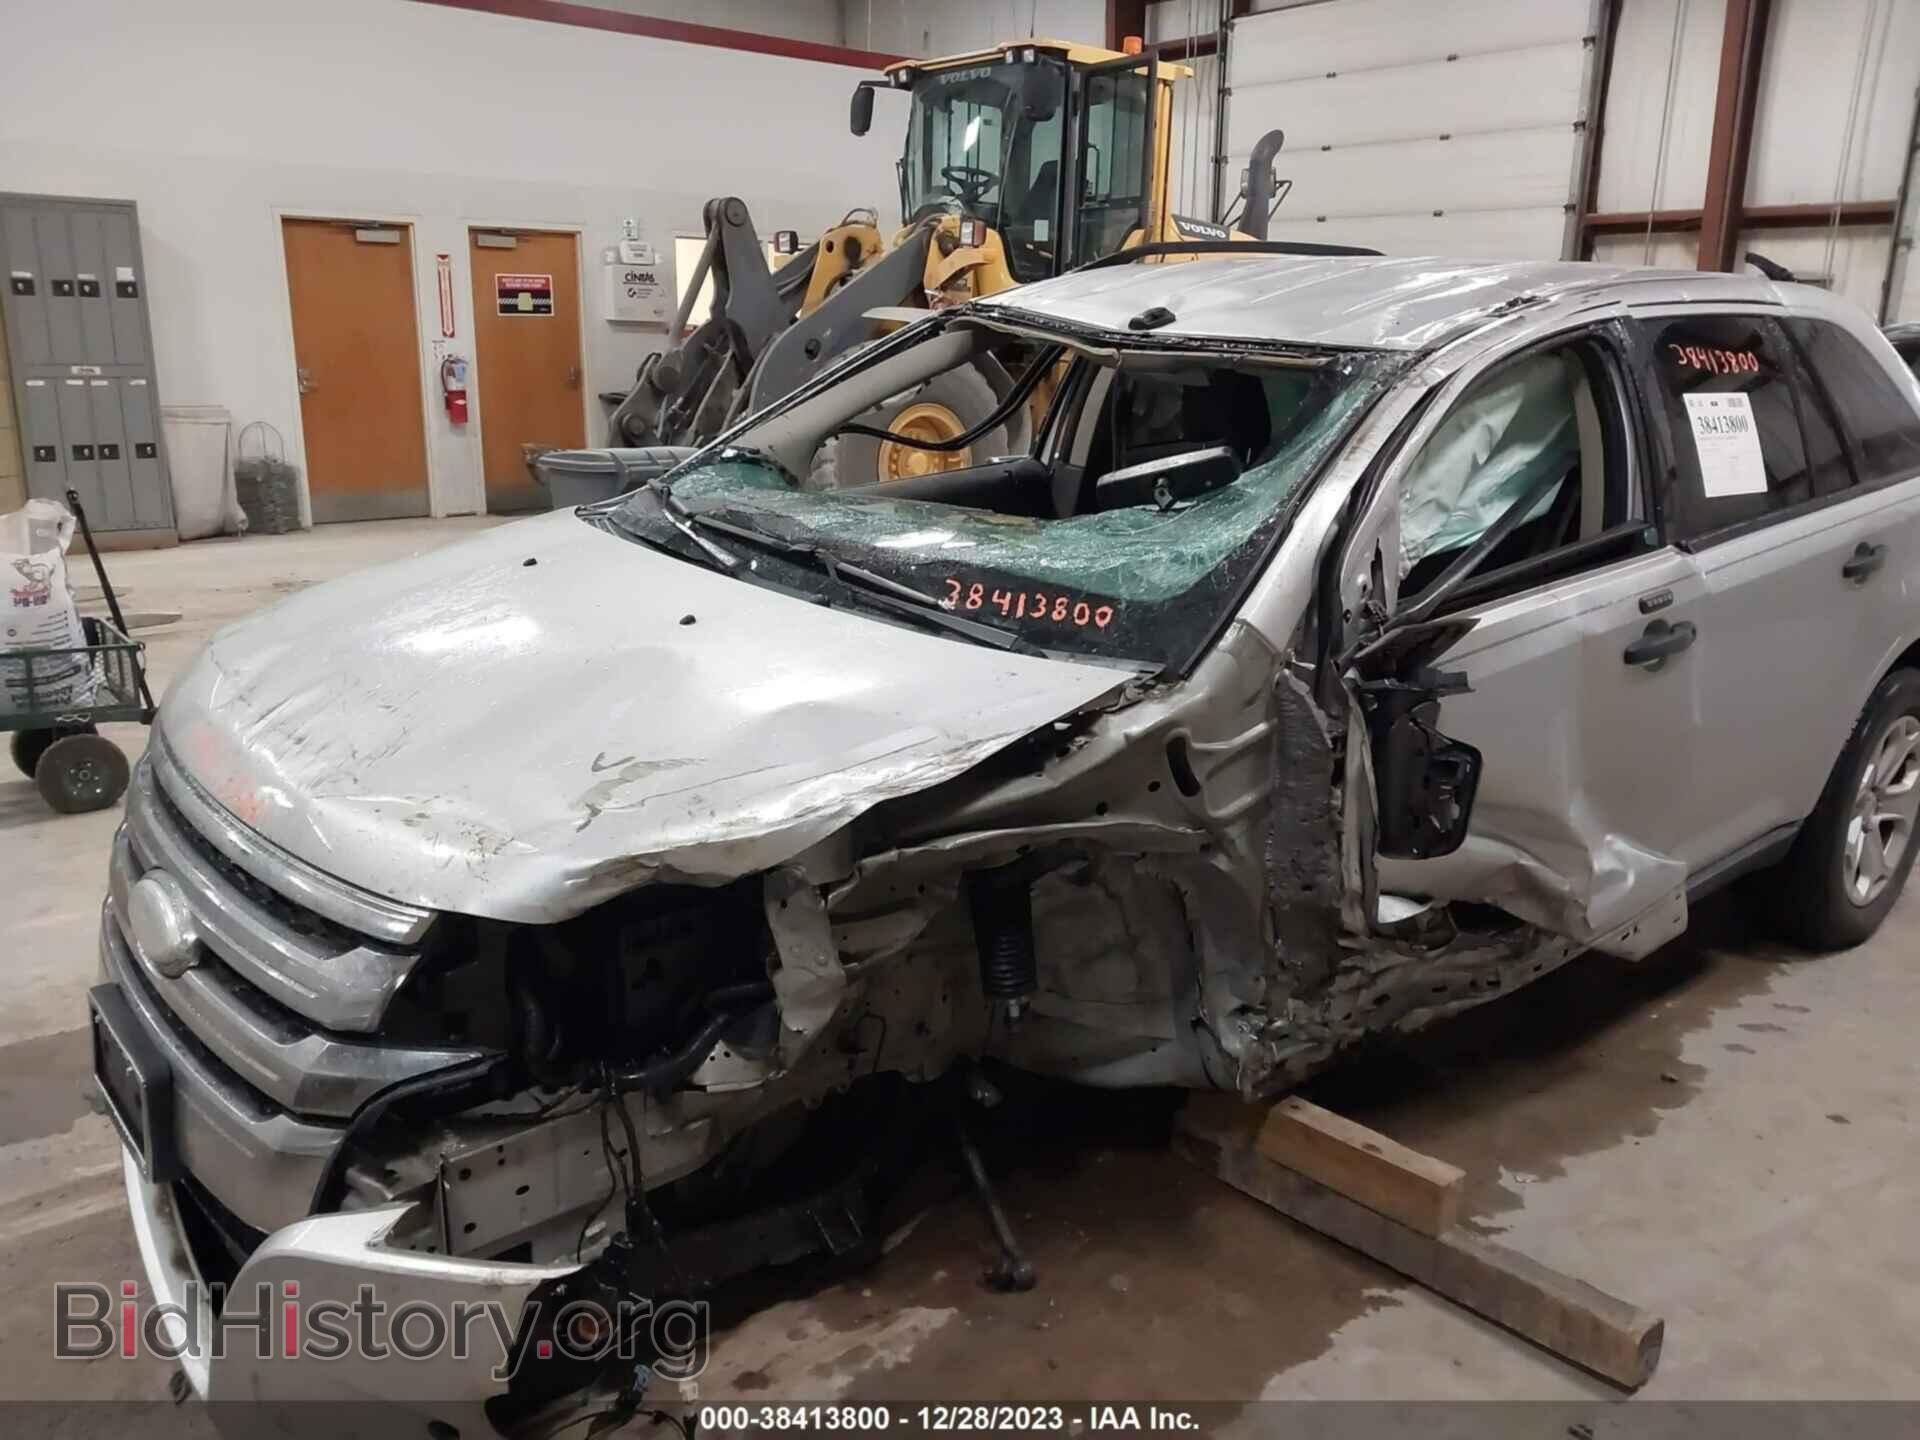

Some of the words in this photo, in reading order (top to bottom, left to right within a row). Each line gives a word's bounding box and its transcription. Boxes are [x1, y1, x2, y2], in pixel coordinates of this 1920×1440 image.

[940, 66, 992, 85] VOLVO
[1178, 221, 1226, 238] VOLVO
[1697, 415, 1749, 435] 38413800
[944, 578, 1114, 628] 38413800
